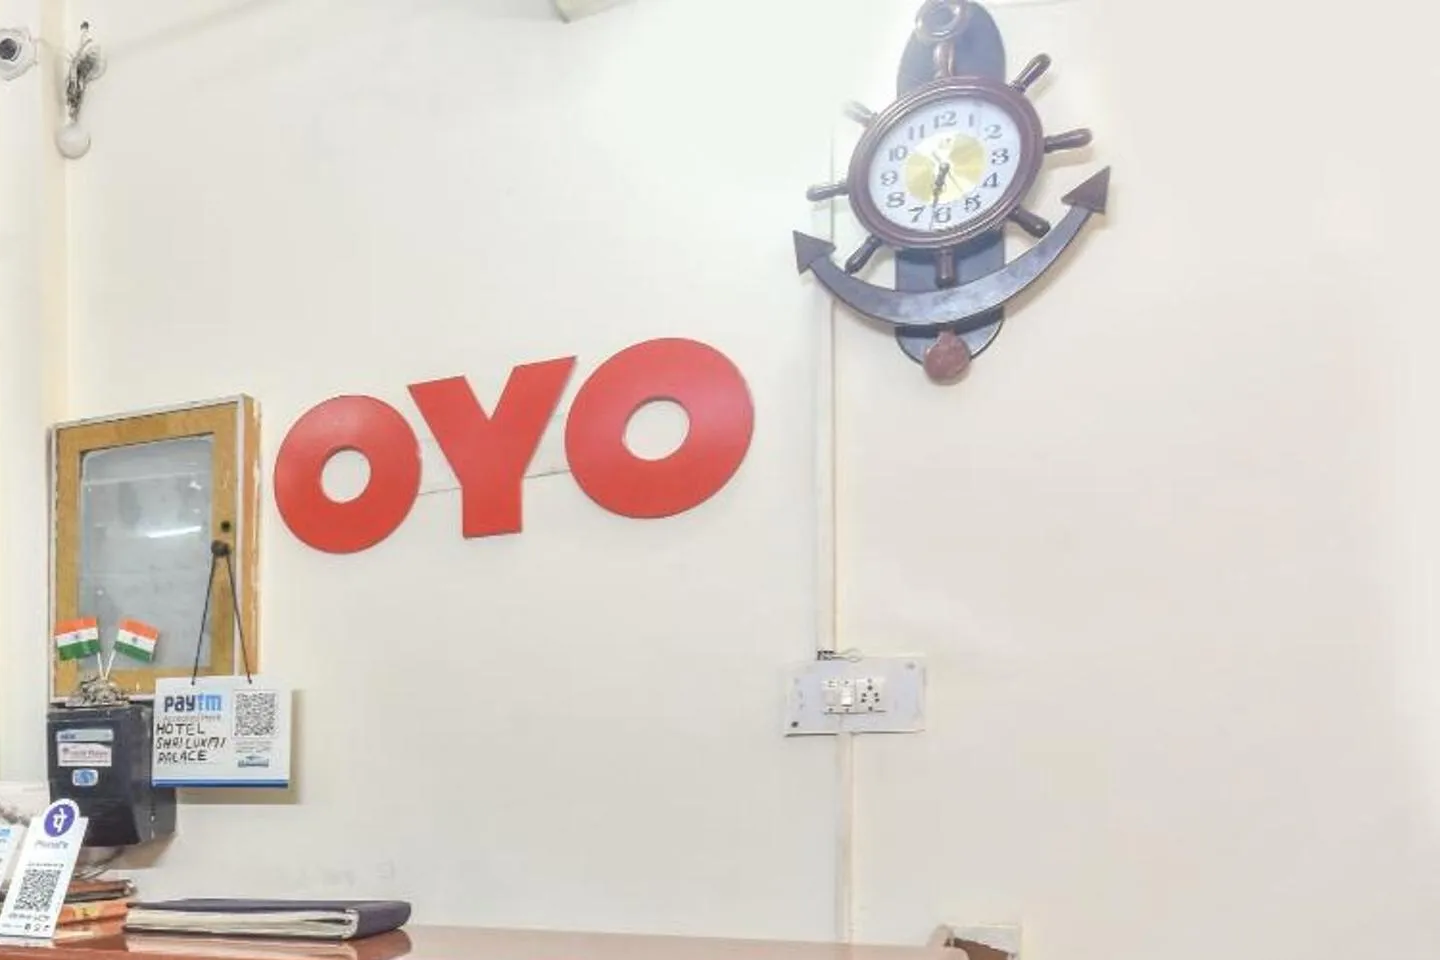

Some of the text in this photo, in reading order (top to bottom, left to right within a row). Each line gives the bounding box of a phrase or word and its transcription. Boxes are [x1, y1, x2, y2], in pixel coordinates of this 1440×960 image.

[933, 110, 958, 129] 12
[968, 113, 976, 128] 1
[908, 124, 926, 141] 11
[984, 123, 1003, 140] 2
[889, 146, 908, 163] 10
[991, 149, 1009, 166] 3
[881, 171, 898, 186] 9
[983, 172, 1000, 189] 4
[886, 192, 905, 209] 8
[964, 195, 982, 211] 5
[908, 206, 924, 223] 7
[934, 206, 952, 223] 6
[273, 337, 755, 555] OYO
[156, 722, 205, 736] HOTEL
